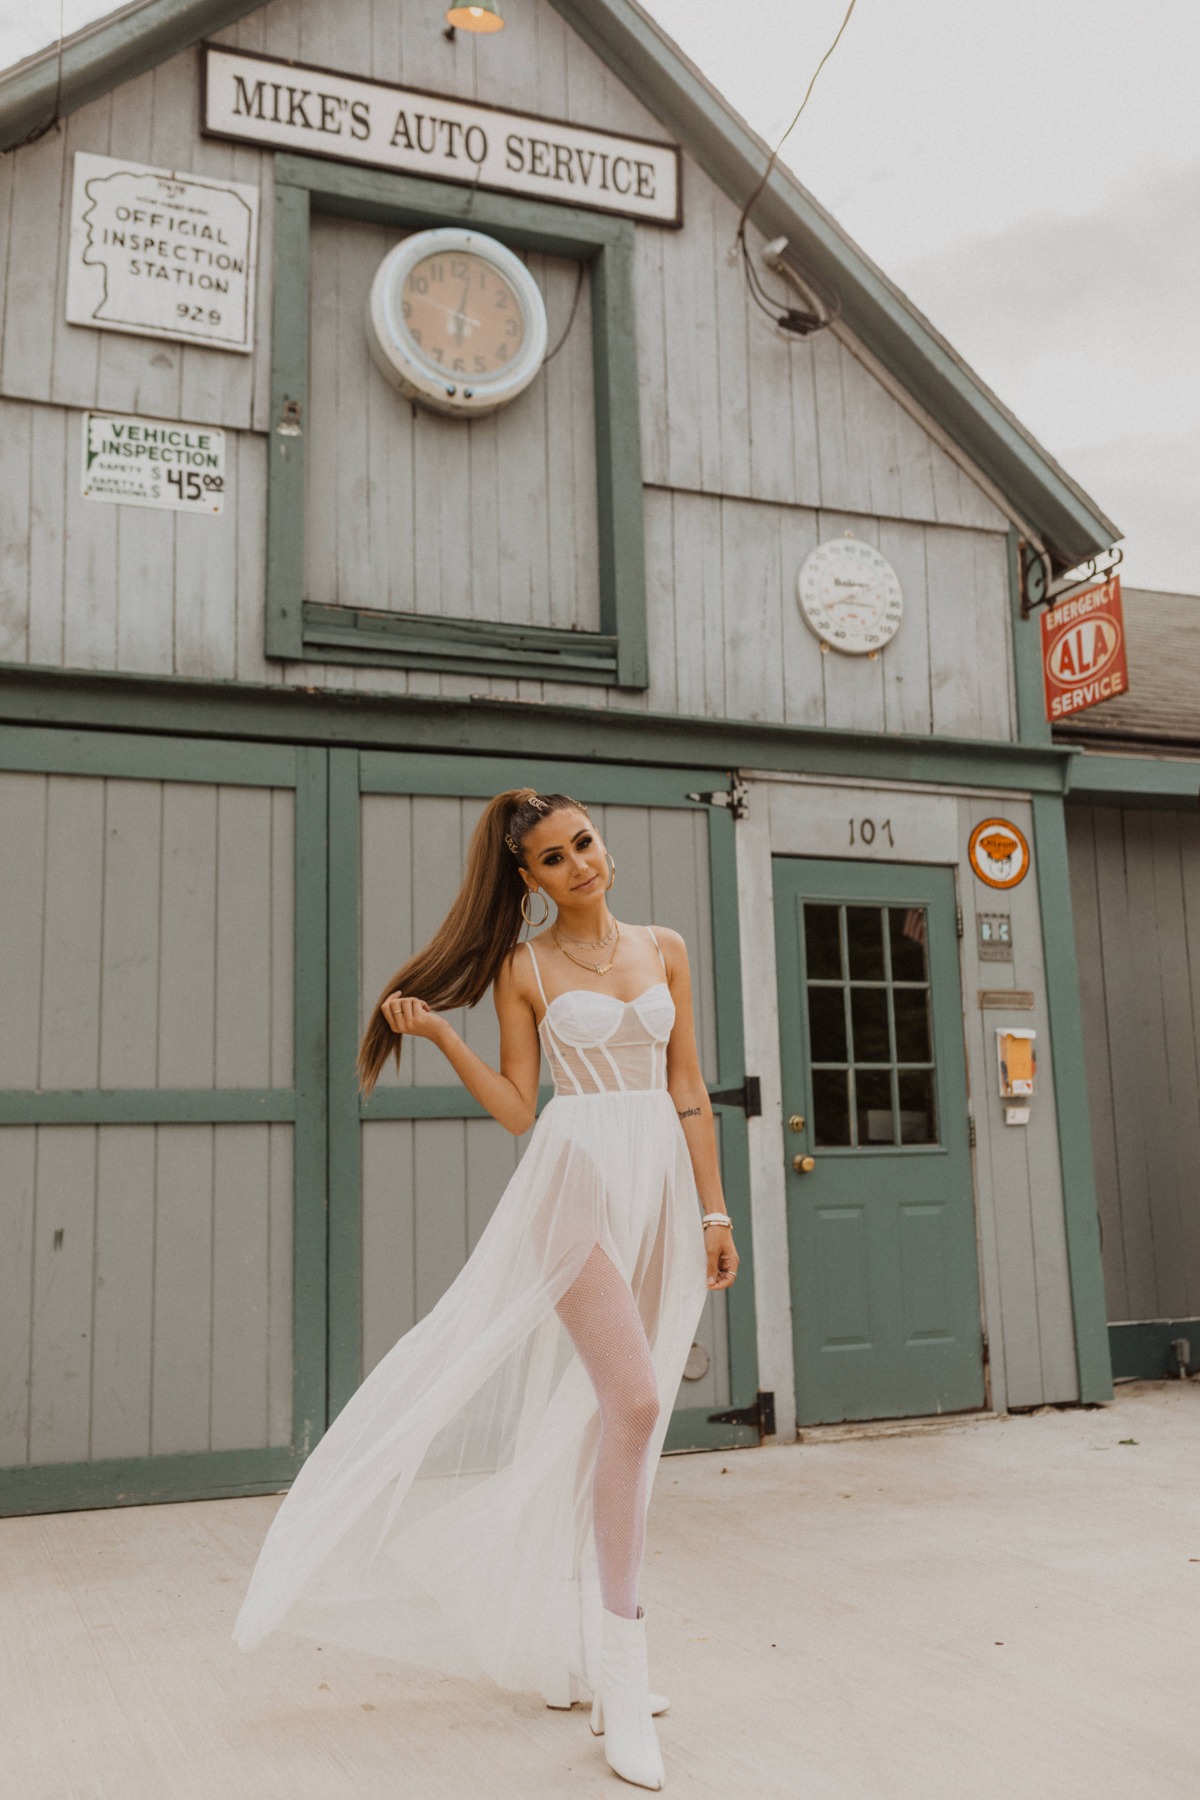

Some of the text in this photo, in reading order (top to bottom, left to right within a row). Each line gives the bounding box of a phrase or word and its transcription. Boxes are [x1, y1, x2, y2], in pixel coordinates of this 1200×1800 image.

[232, 75, 656, 200] MIKE'S AUTO SERVICE
[115, 206, 229, 246] OFFICIAL
[103, 228, 244, 274] INSPECTION
[129, 259, 229, 294] STATION
[102, 440, 218, 468] INSPECTION
[112, 423, 211, 450] VEHICLE
[1045, 581, 1116, 631] EMERGENCY
[1059, 623, 1110, 677] ALA
[1051, 671, 1123, 717] SERVICE
[848, 818, 894, 848] 101
